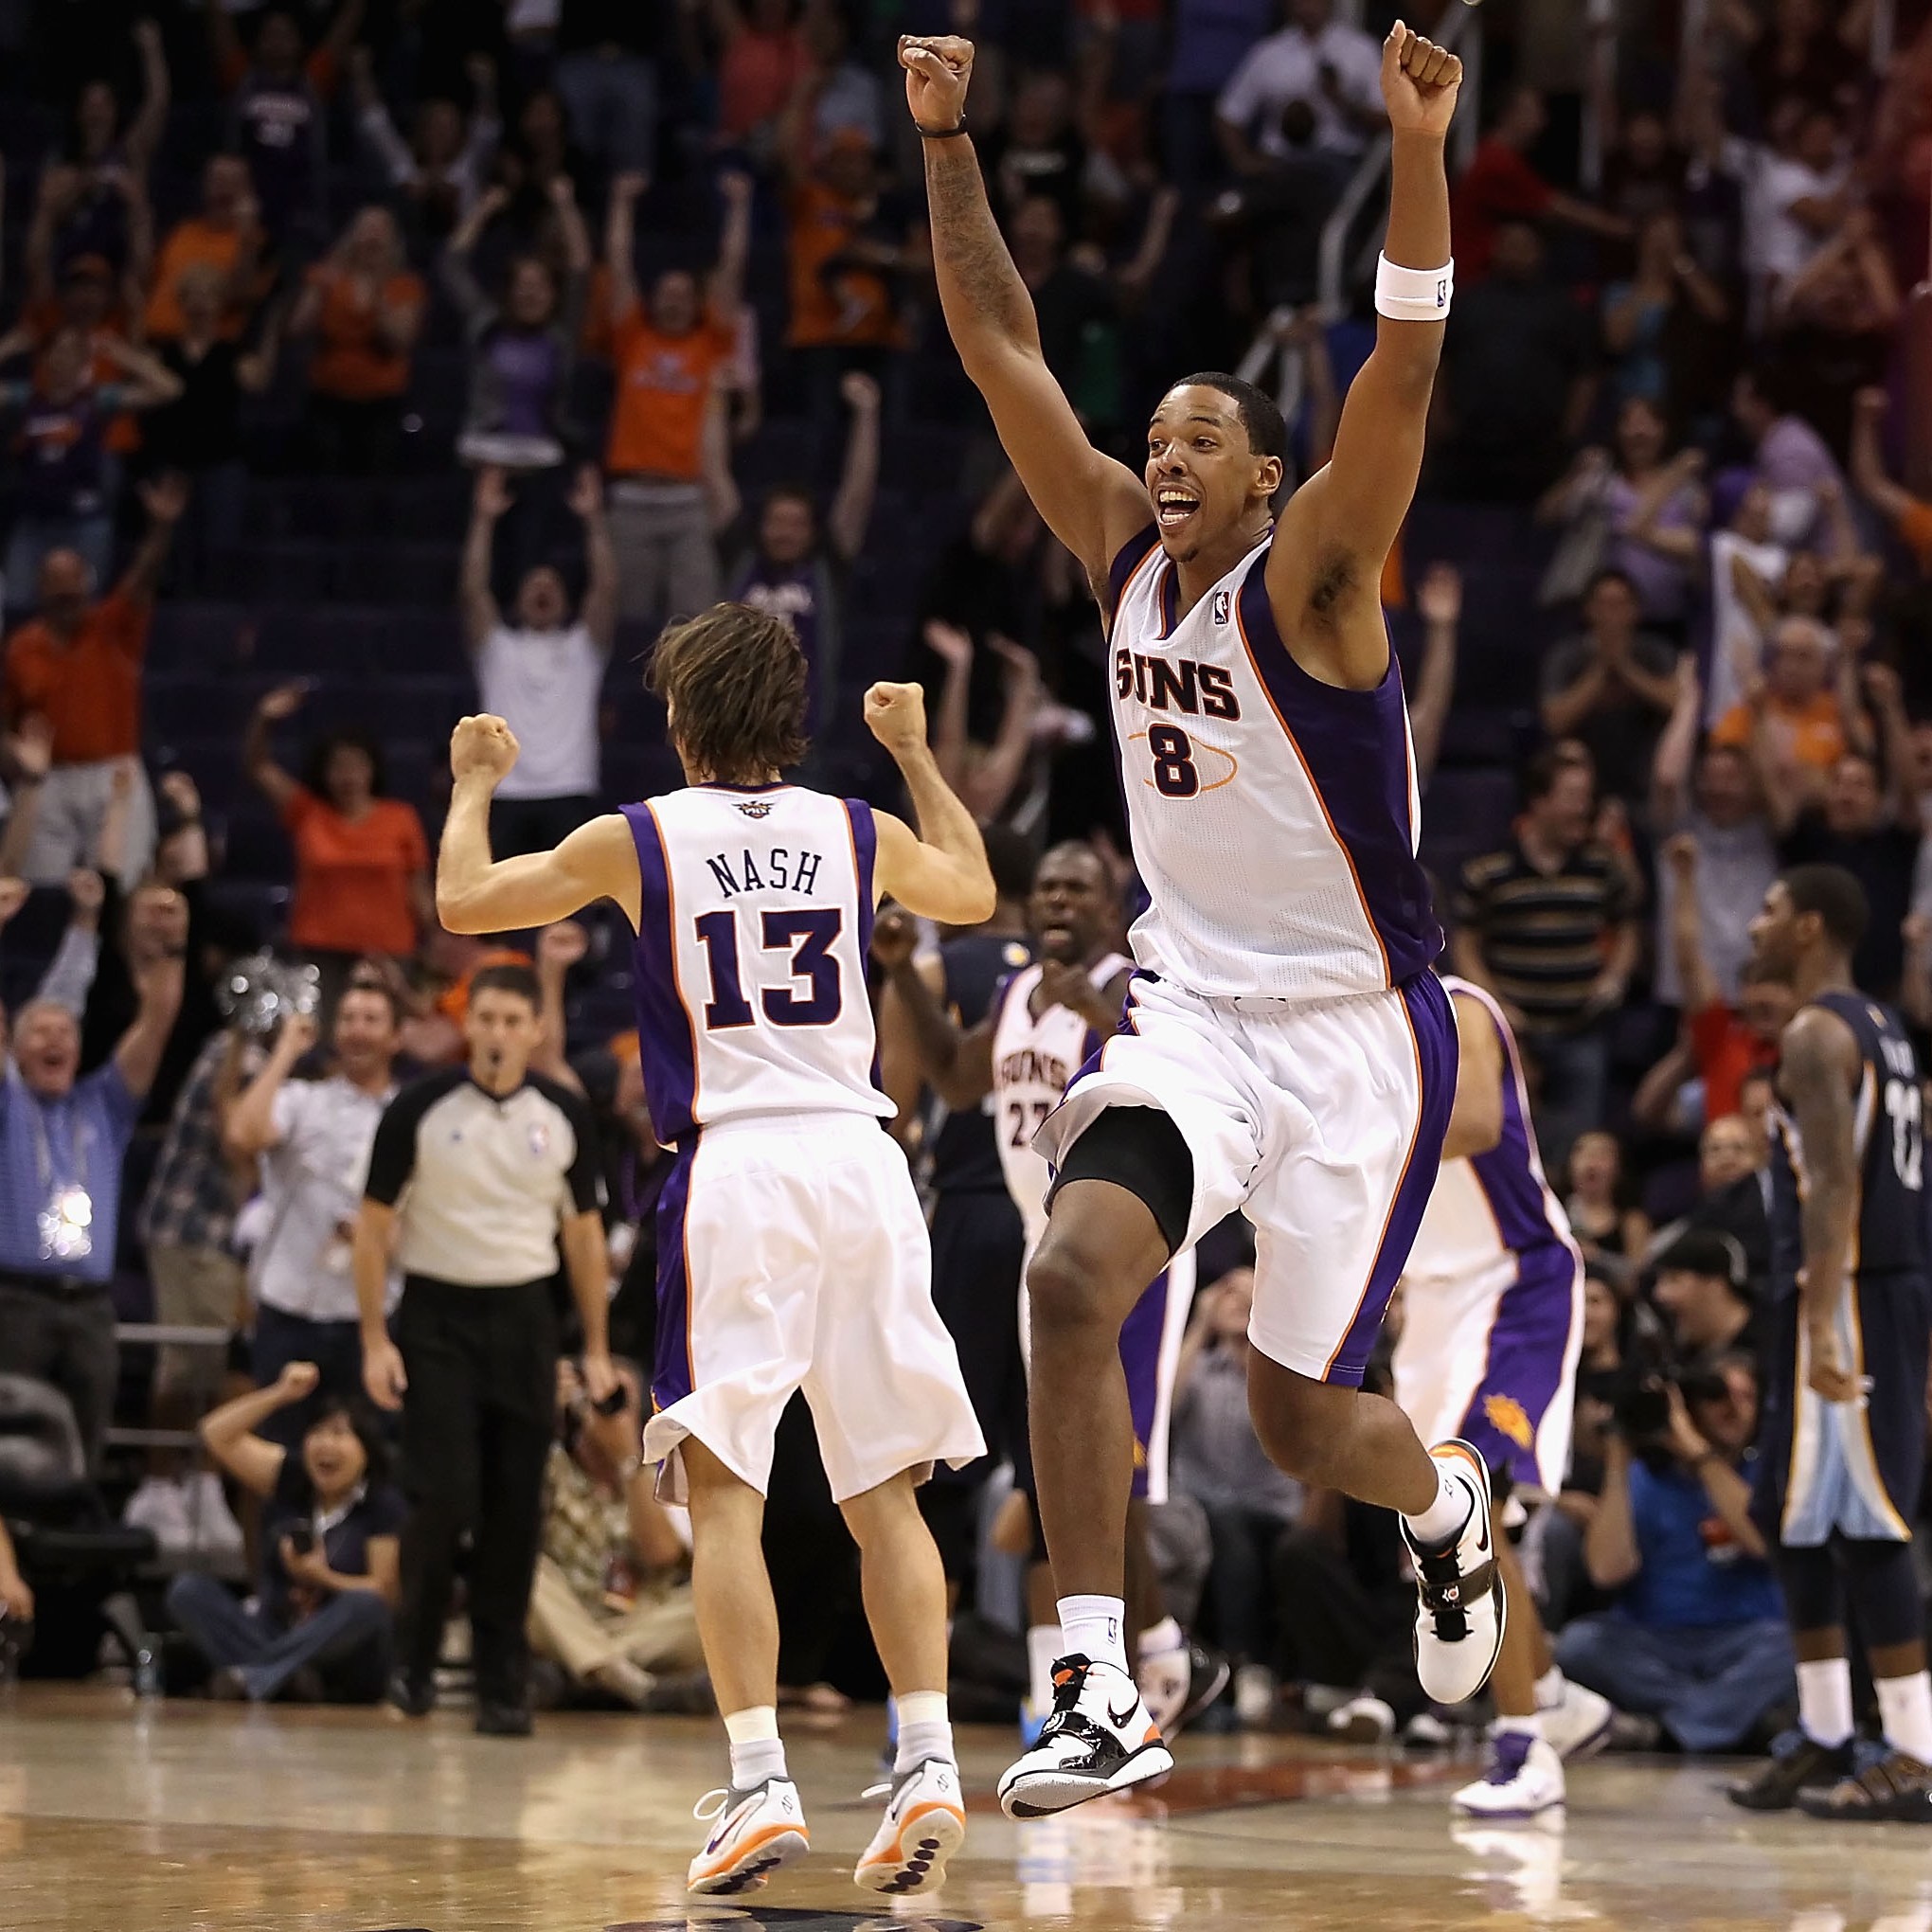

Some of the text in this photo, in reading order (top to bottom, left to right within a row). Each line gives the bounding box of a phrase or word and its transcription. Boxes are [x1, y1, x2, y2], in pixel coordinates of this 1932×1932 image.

[1116, 649, 1242, 722] SUNS
[1148, 722, 1201, 798] 8
[706, 848, 822, 899] NASH
[693, 906, 844, 1031] 13
